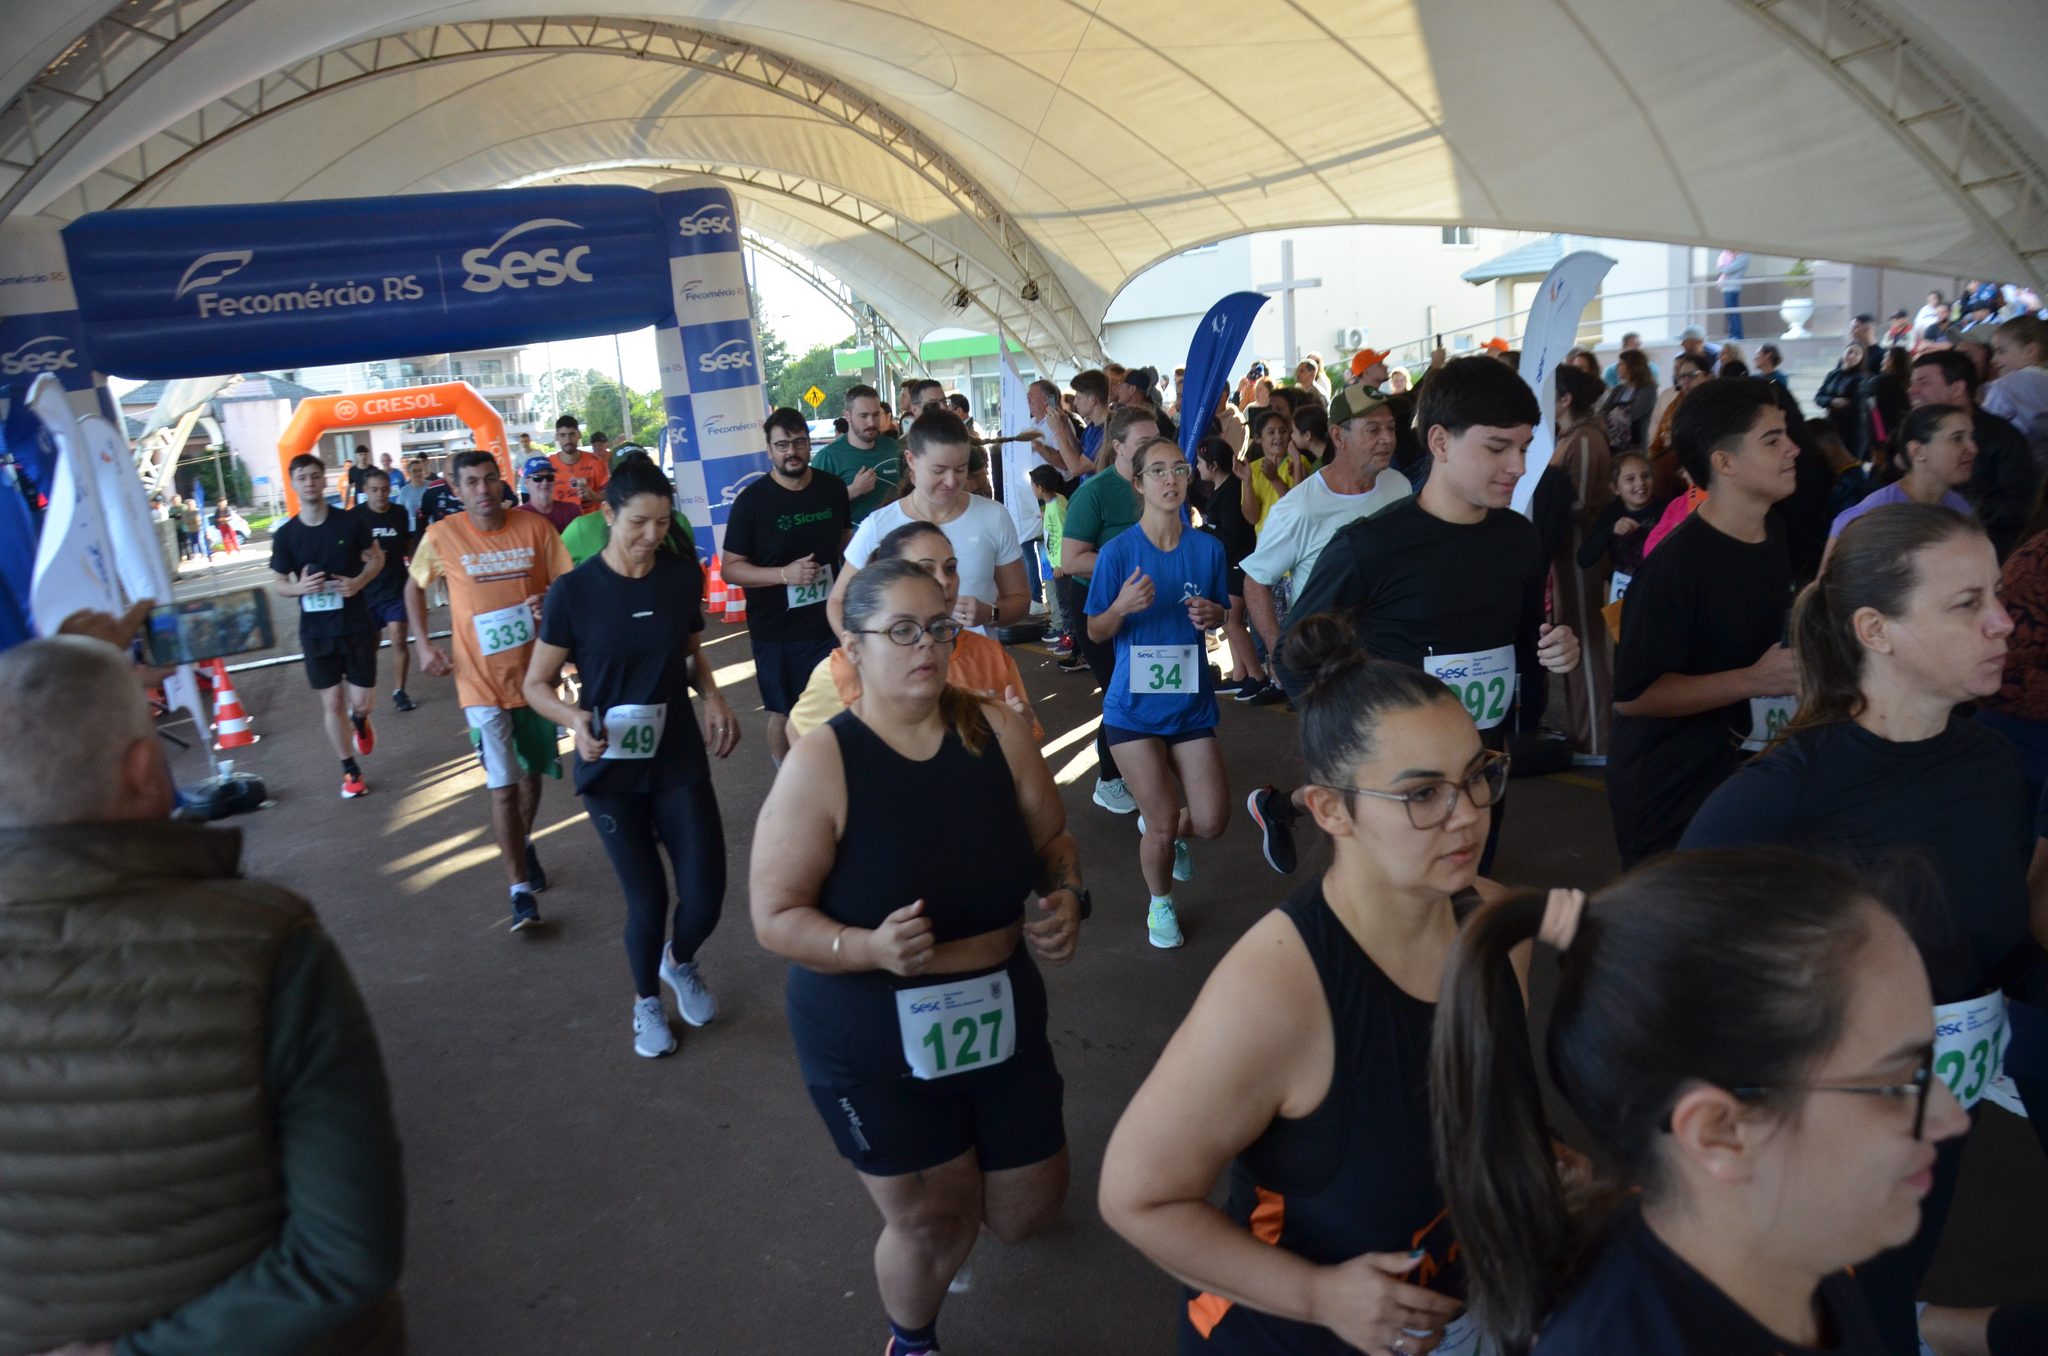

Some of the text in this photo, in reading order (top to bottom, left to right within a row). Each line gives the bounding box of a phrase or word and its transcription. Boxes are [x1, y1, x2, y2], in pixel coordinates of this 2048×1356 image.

[679, 216, 732, 236] Sesc
[461, 245, 593, 293] Sesc
[198, 274, 424, 318] Fecomércio RS
[685, 288, 736, 300] Fecomércio
[1, 349, 78, 375] Sesc
[699, 351, 753, 373] Sesc
[363, 392, 442, 415] CRESOL
[708, 422, 758, 435] Fecomércio
[794, 508, 832, 526] Sicredi
[371, 528, 398, 538] FILA
[308, 592, 336, 608] 157
[795, 579, 828, 604] 247
[486, 620, 528, 650] 333
[1149, 663, 1182, 690] 34
[1435, 666, 1468, 680] Sesc
[621, 725, 654, 754] 49
[923, 1008, 1003, 1072] 127
[1935, 1021, 1964, 1037] esc
